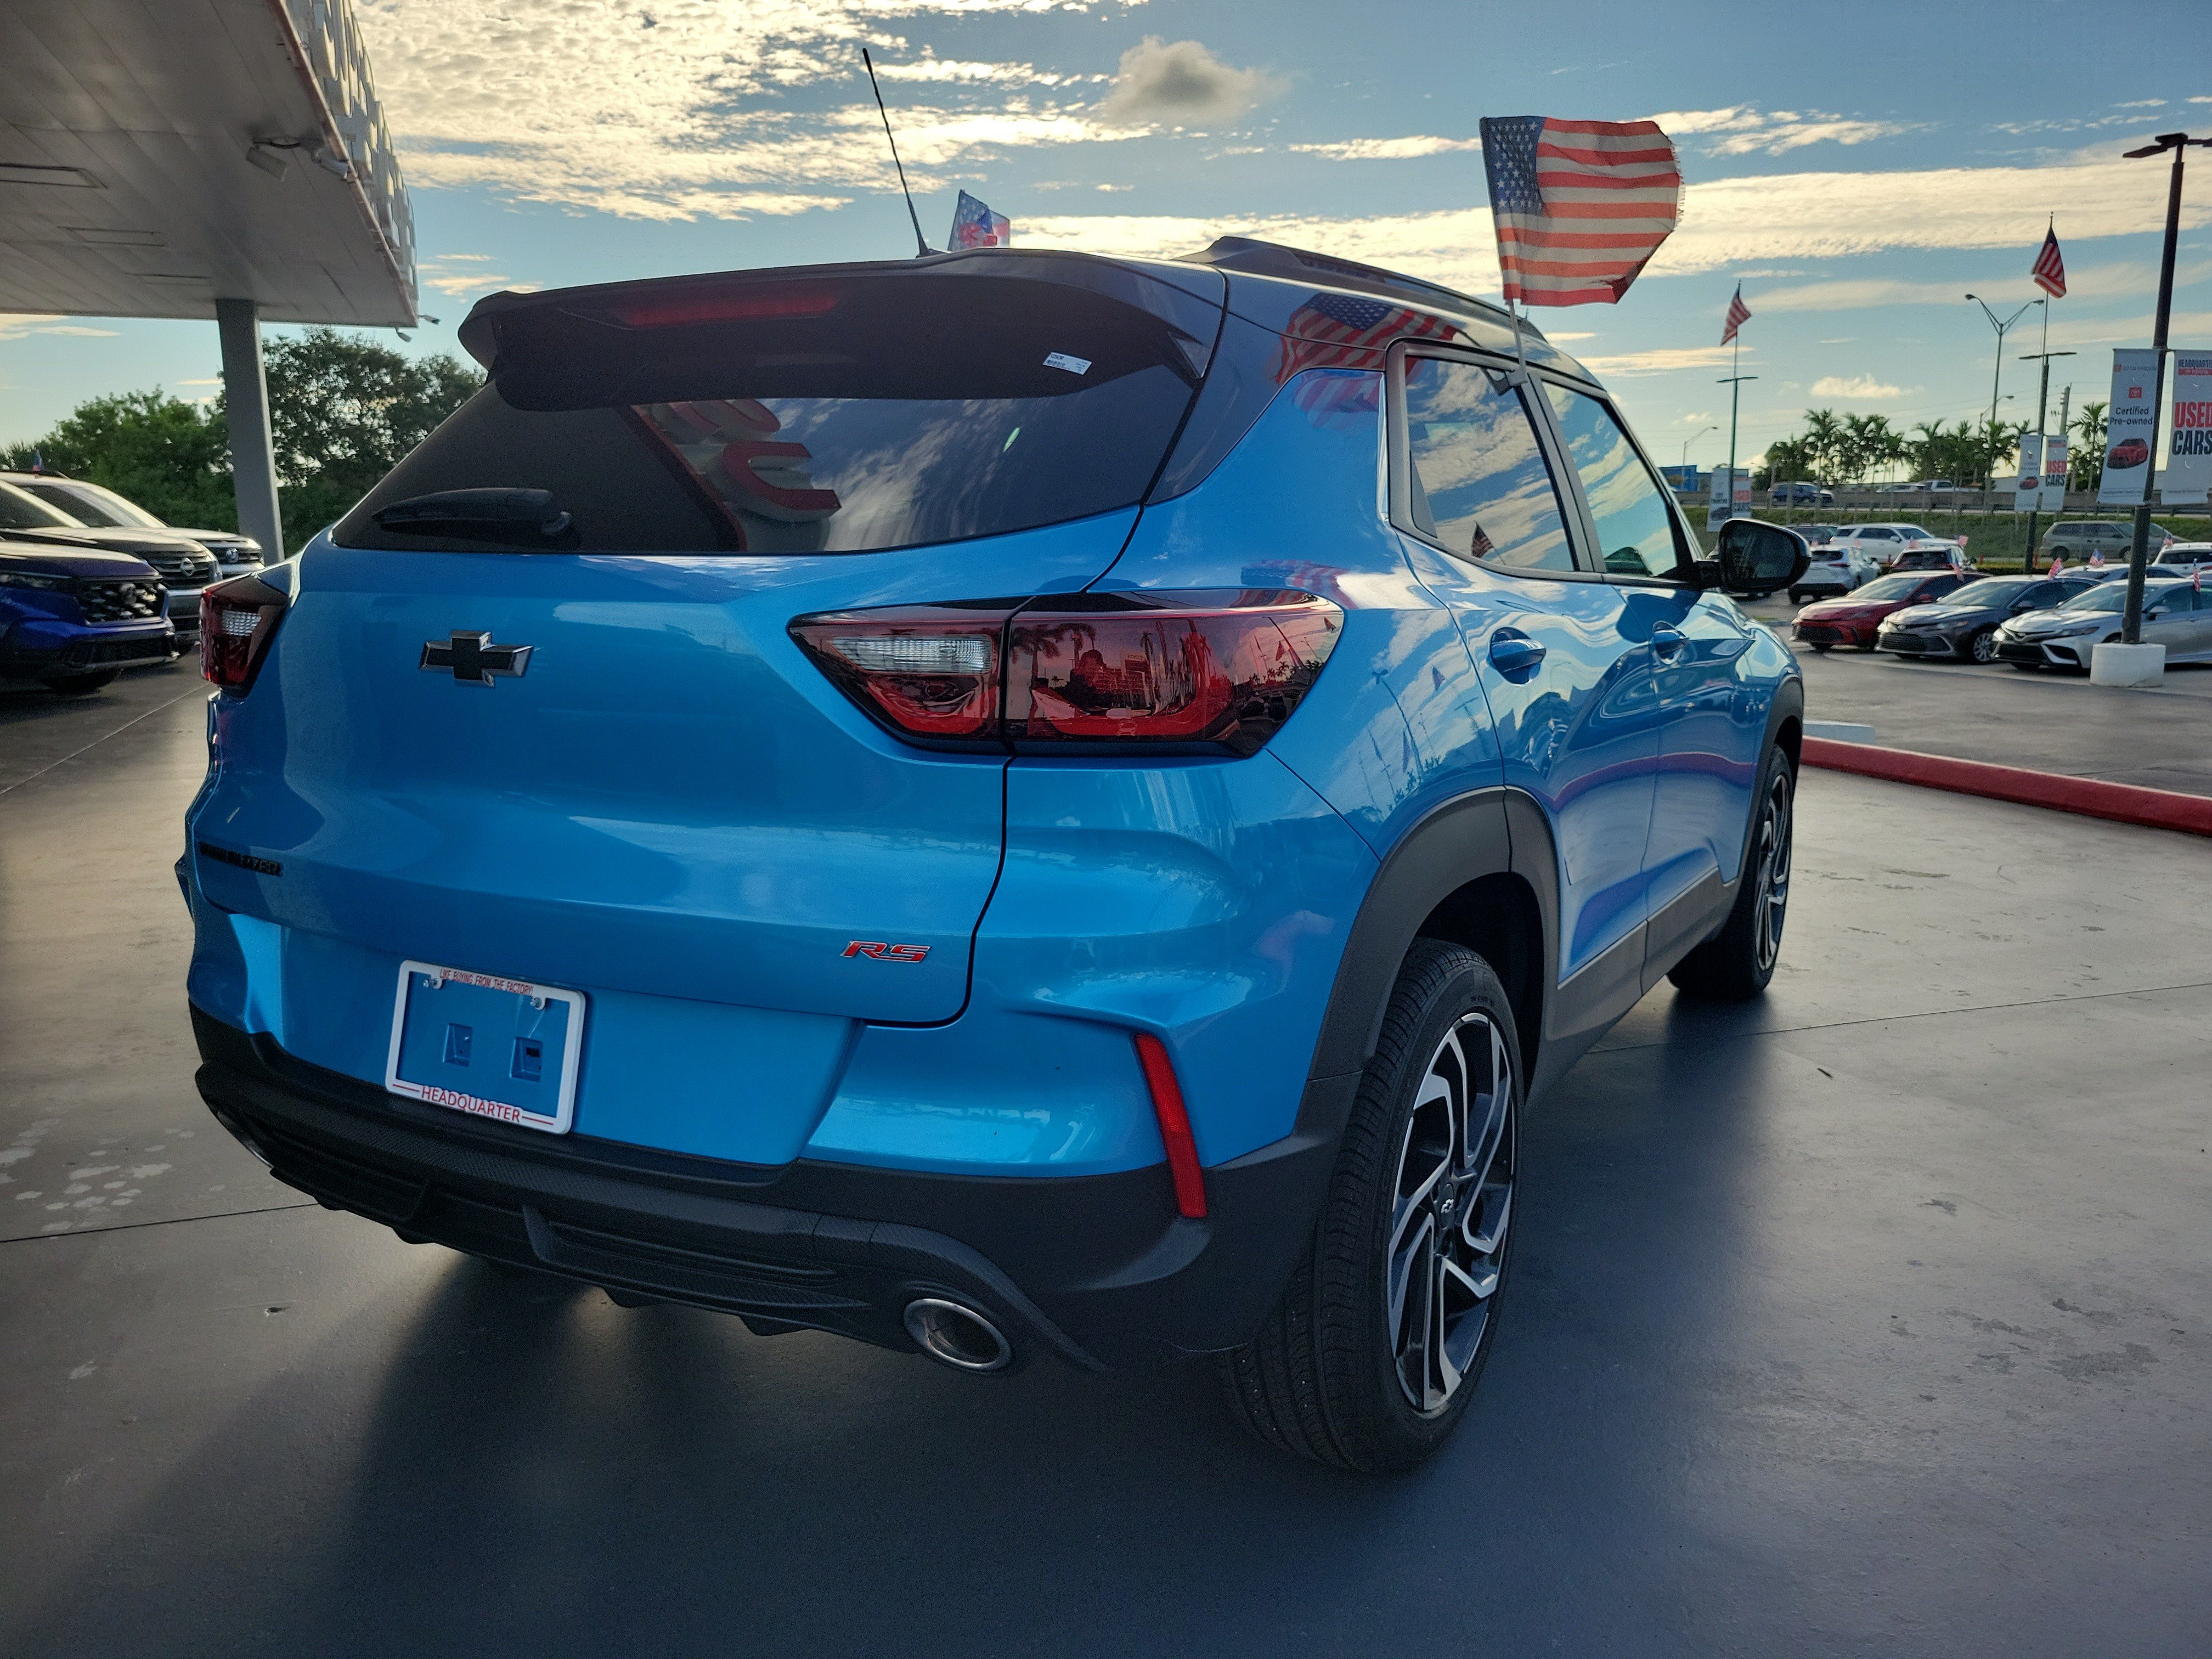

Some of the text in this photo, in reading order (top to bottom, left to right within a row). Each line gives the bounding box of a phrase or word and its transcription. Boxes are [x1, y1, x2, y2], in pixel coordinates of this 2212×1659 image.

[2110, 417, 2153, 425] Pre-owned
[2115, 405, 2149, 415] Certified
[2174, 402, 2212, 428] USED
[2172, 430, 2212, 455] CARS
[2047, 460, 2067, 473] USED
[2045, 475, 2065, 487] CARS
[840, 940, 930, 963] RS
[440, 968, 452, 979] LIKE
[453, 971, 473, 984] BUYING
[476, 975, 492, 988] FROM
[494, 979, 505, 990] THE
[421, 1086, 520, 1123] HEADQUARTER
